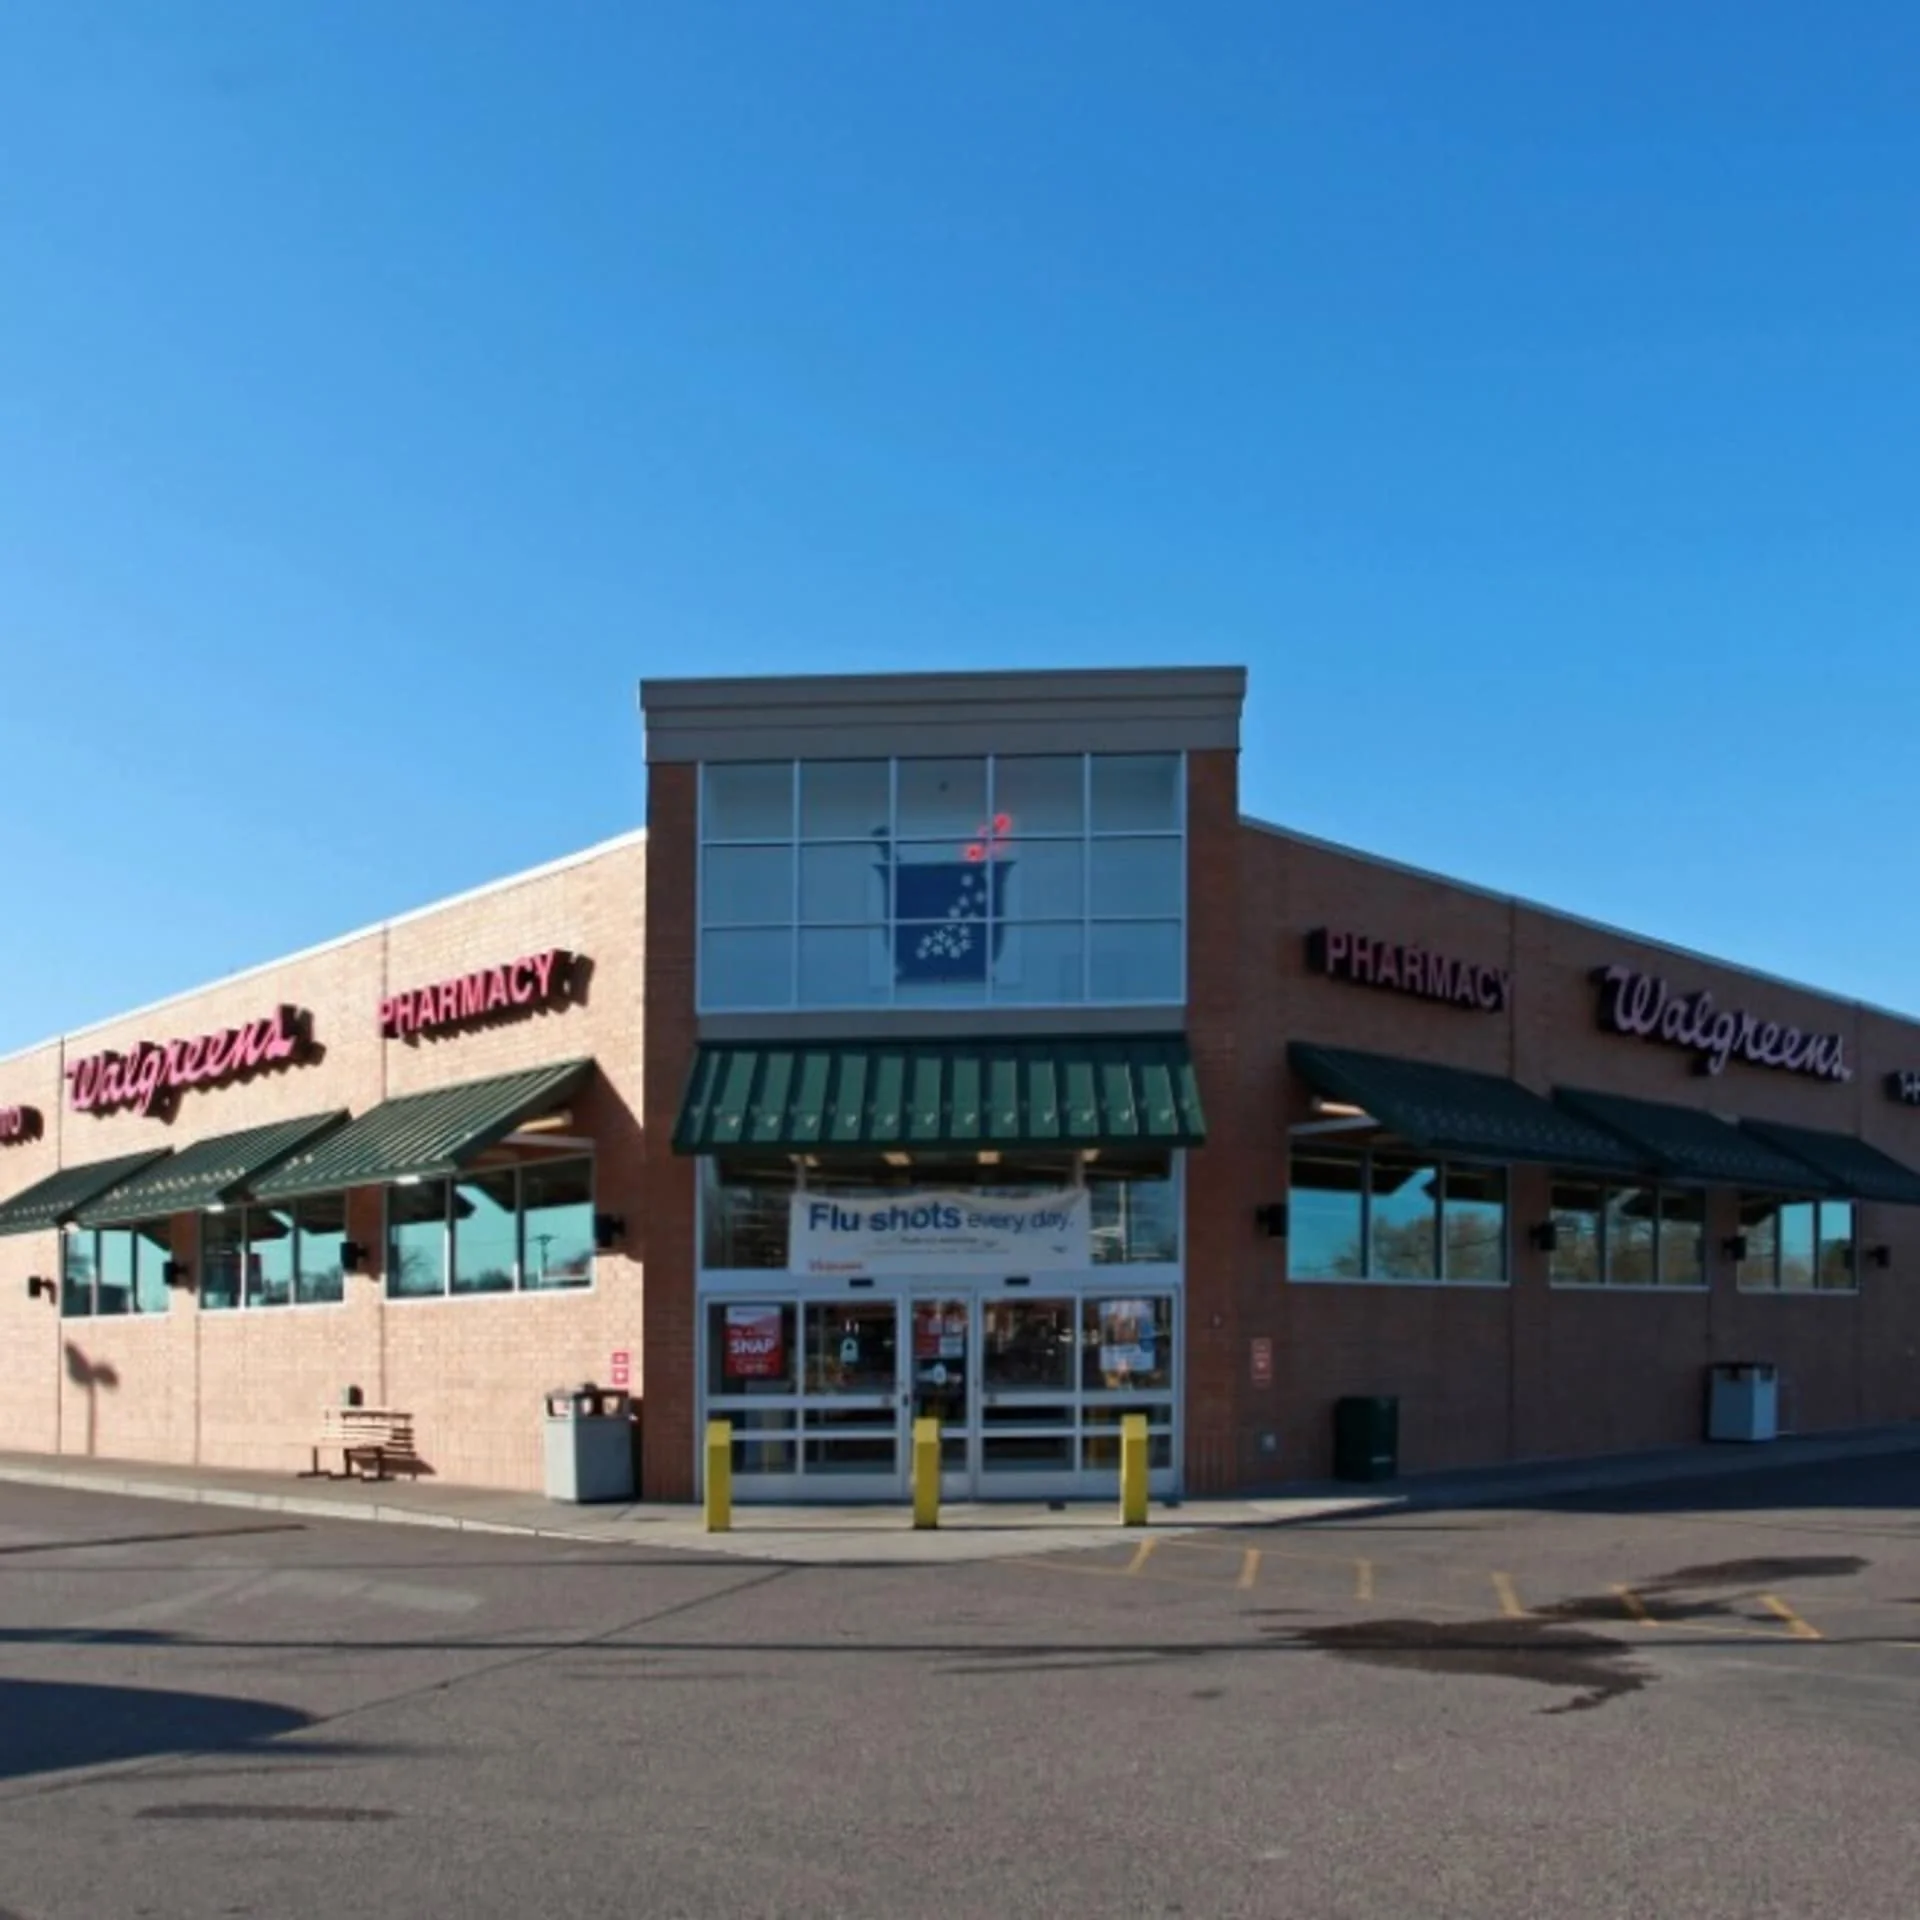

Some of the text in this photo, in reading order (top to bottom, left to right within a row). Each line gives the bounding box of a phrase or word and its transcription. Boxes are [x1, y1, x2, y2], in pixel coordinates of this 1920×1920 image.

[378, 948, 558, 1034] PHARMACY
[1326, 931, 1518, 1009] PHARMACY
[66, 1006, 294, 1116] Walgreens
[1605, 965, 1854, 1080] Walgreens
[808, 1202, 860, 1232] Flu
[869, 1201, 961, 1231] shots
[967, 1210, 1025, 1233] every
[729, 1338, 776, 1354] SNAP
